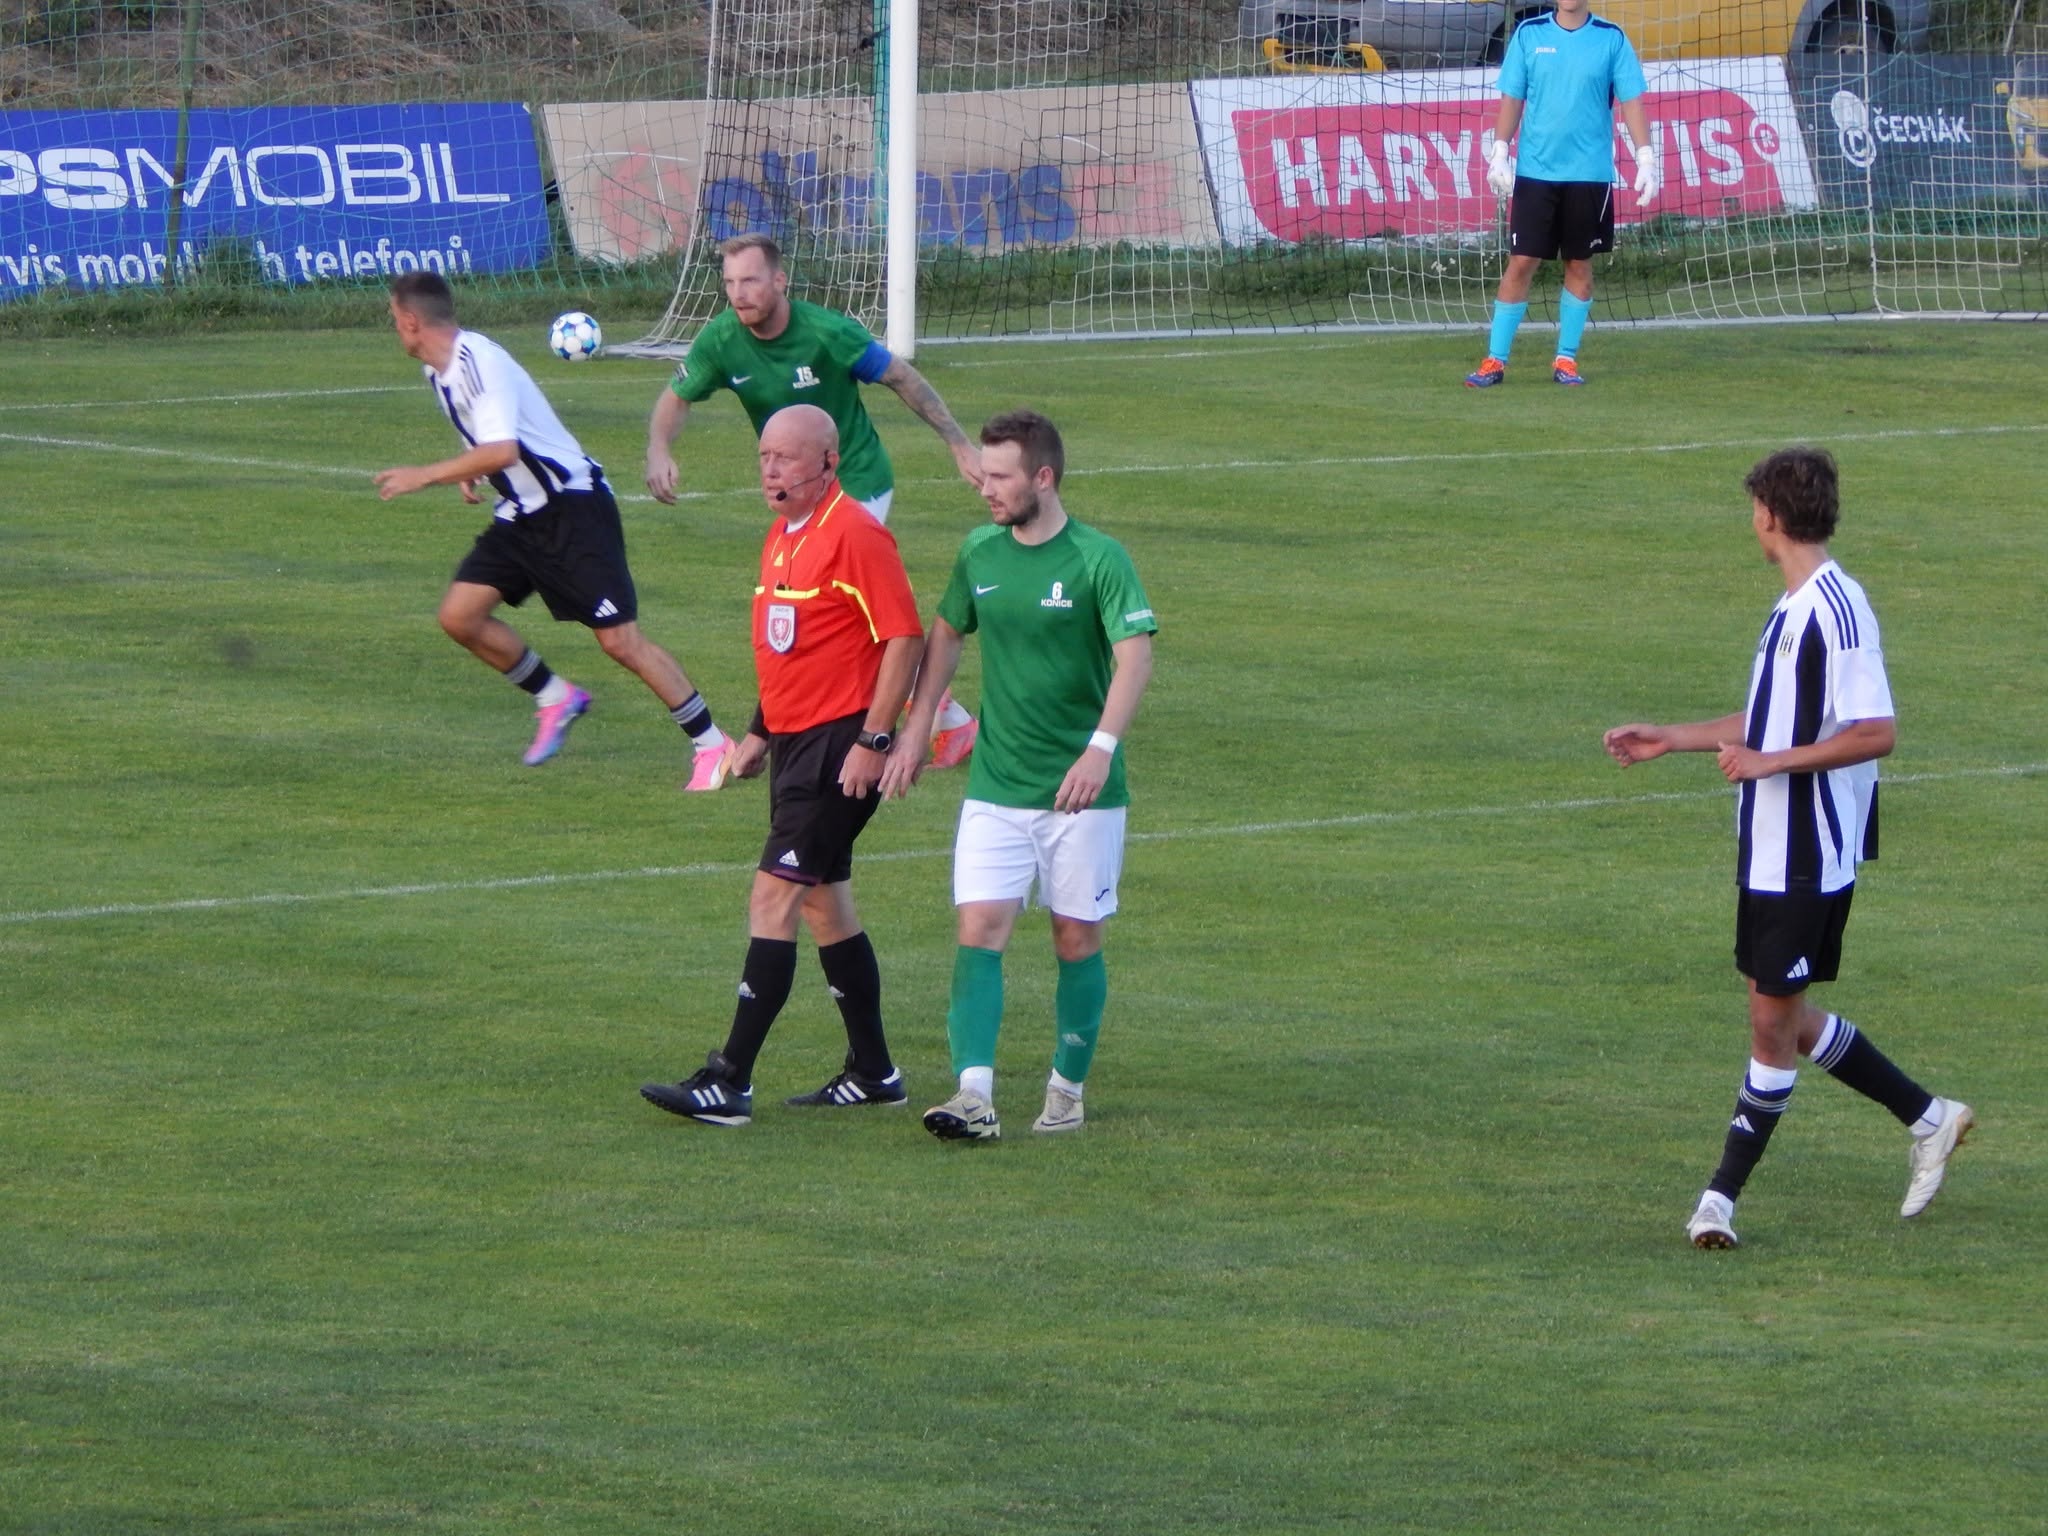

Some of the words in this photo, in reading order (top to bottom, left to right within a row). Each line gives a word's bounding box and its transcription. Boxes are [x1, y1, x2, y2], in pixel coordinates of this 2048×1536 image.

[1873, 107, 1972, 144] ČECHÁK
[1271, 117, 1744, 208] HARYVIS
[0, 243, 67, 285] vis
[295, 235, 472, 282] telefonů
[1041, 598, 1073, 608] KONICE
[1052, 581, 1062, 600] 6
